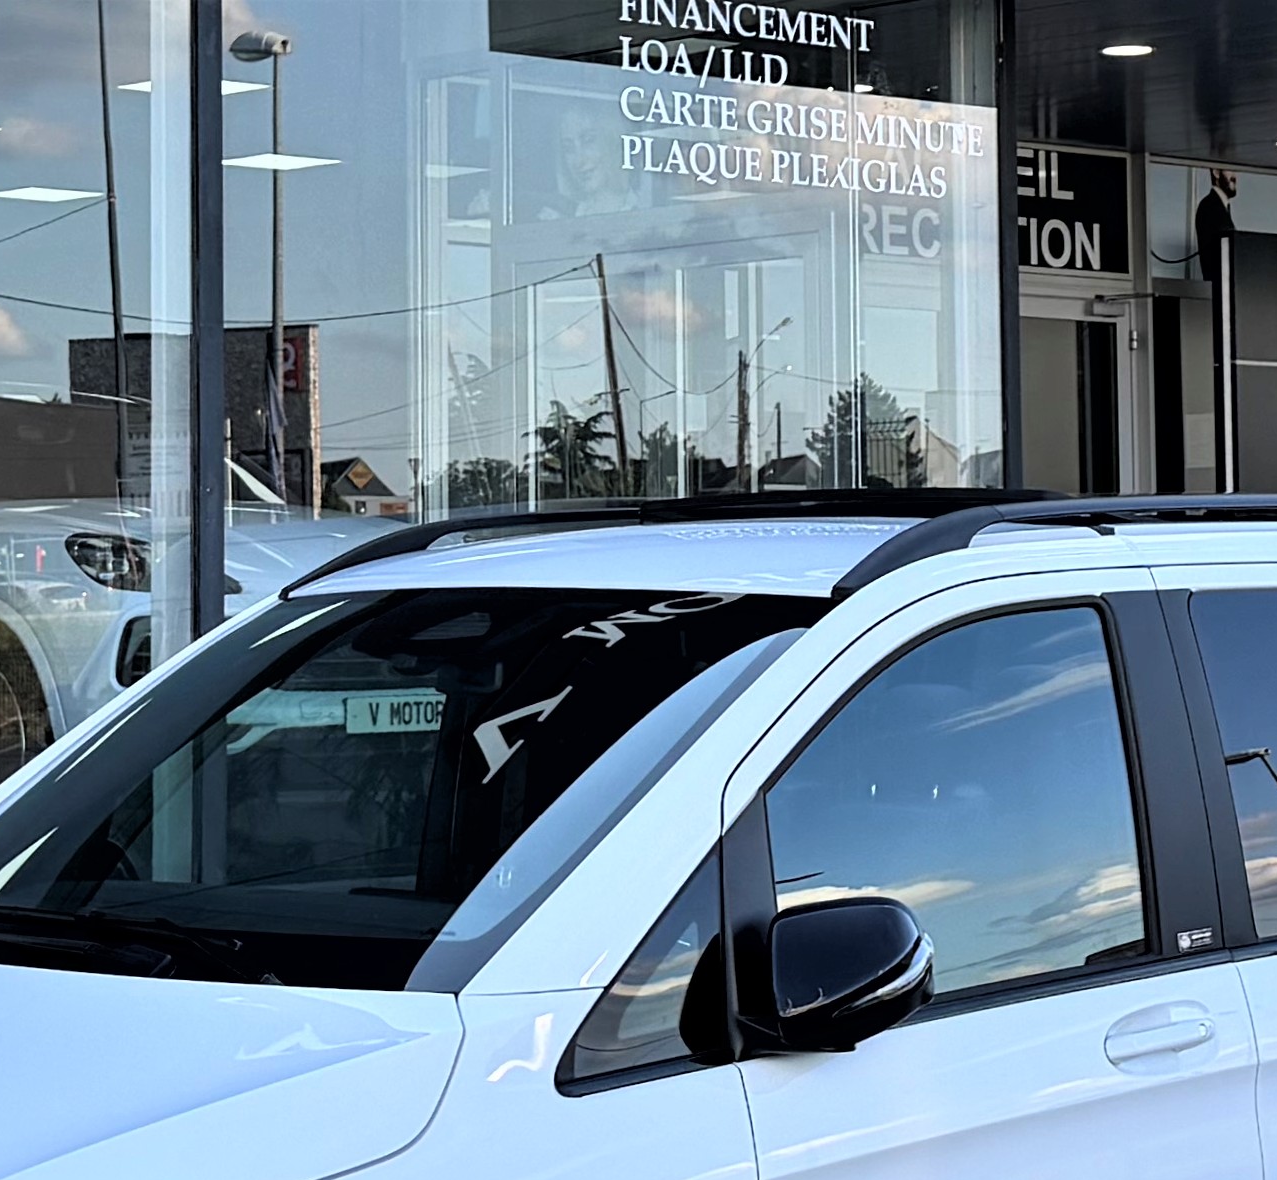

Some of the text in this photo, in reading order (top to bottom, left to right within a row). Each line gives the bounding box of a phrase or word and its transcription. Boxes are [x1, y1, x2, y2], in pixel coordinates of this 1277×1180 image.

[619, 0, 874, 52] FINANCEMENT
[620, 86, 984, 157] CARTE GRISE MINUTE
[621, 135, 763, 185] PLAQUE
[771, 149, 948, 200] PLEXIGLAS
[368, 702, 380, 726] V
